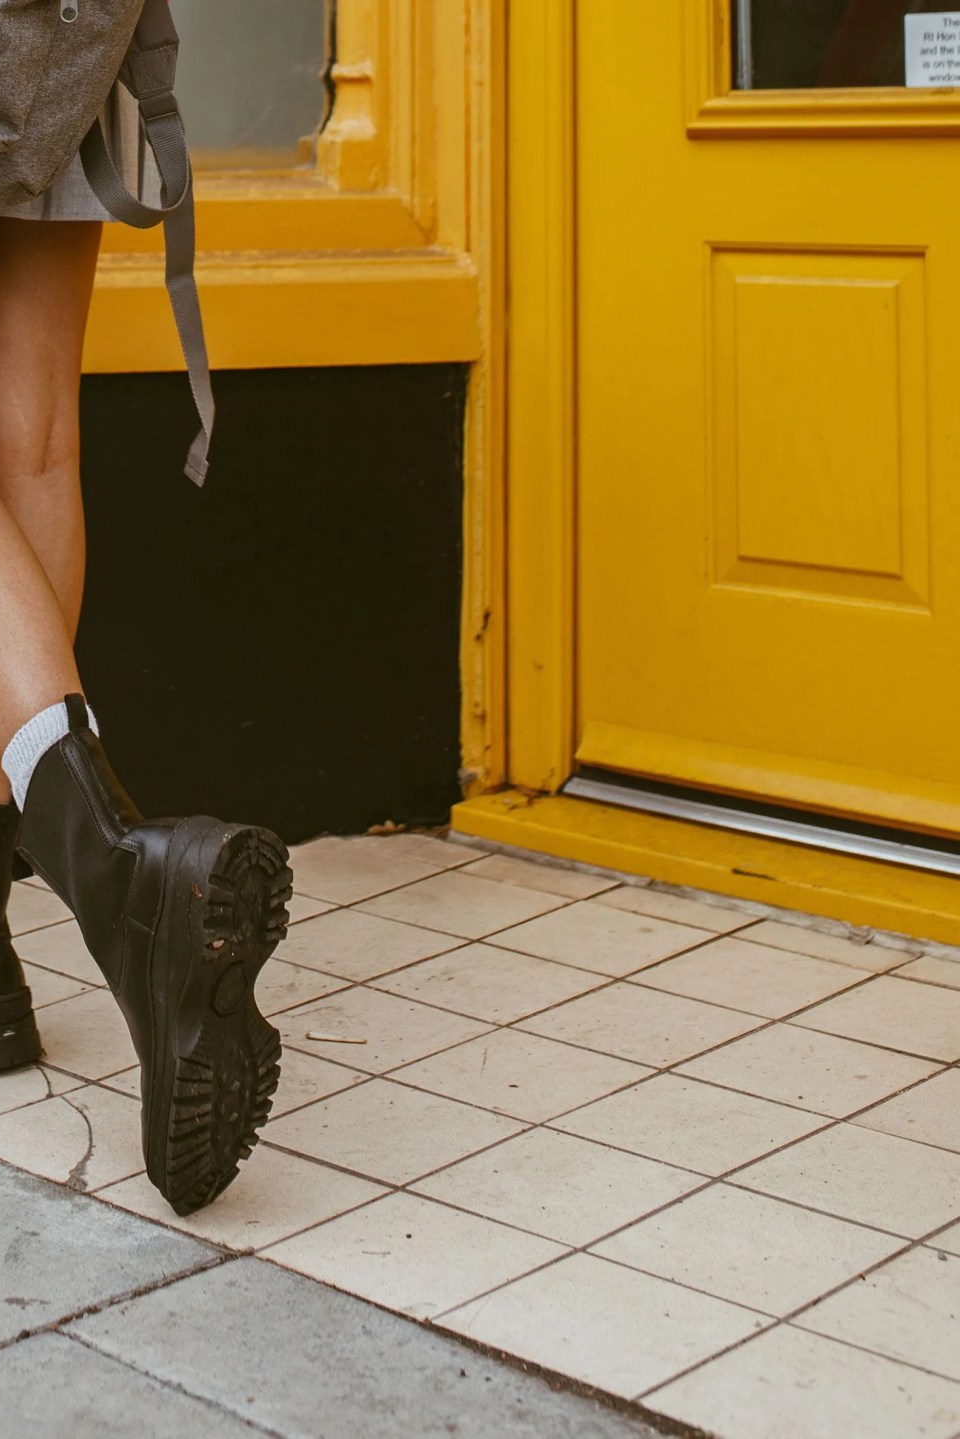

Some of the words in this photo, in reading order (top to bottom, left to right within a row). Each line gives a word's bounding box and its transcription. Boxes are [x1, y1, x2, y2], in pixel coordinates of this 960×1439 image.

[936, 31, 956, 40] Hon
[920, 46, 937, 56] and
[940, 46, 955, 55] the
